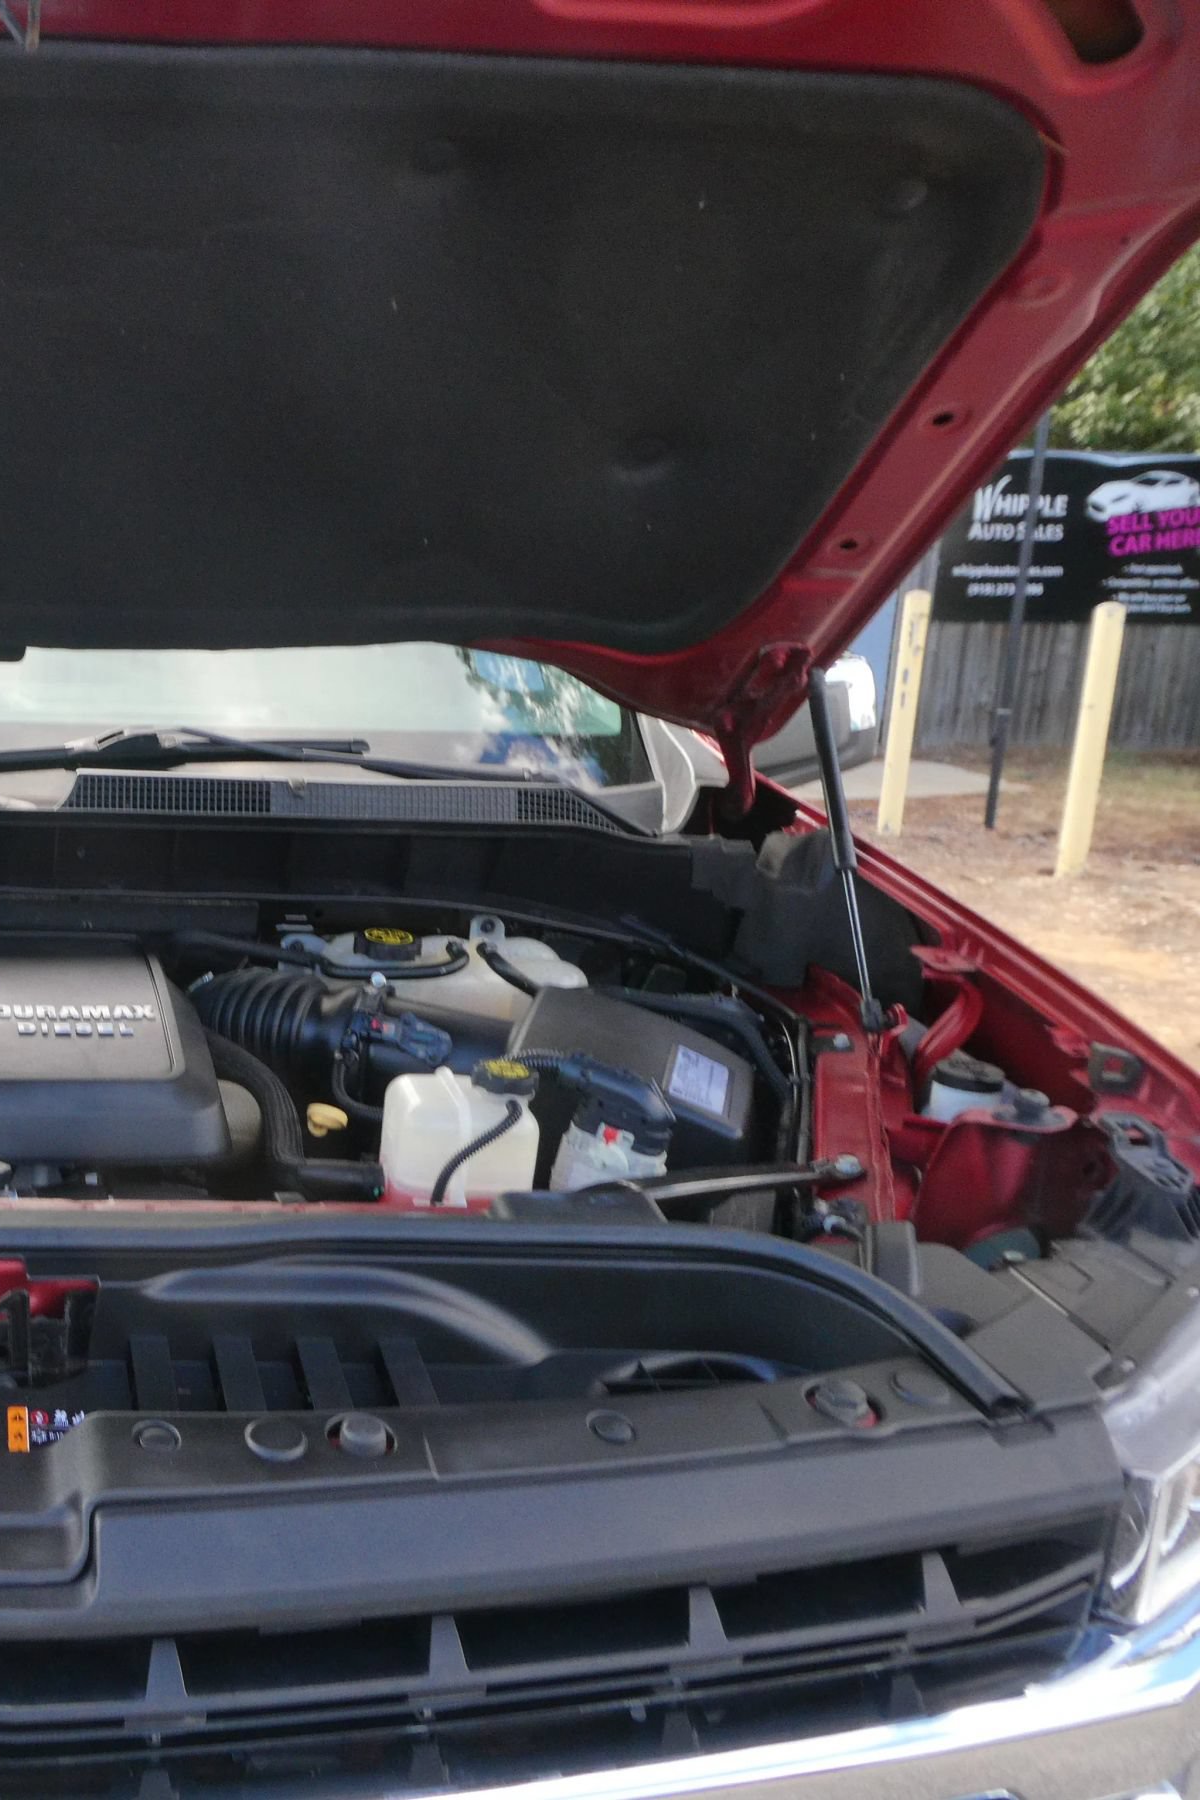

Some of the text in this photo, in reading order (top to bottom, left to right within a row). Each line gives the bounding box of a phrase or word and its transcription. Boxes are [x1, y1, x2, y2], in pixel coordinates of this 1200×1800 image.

[1106, 512, 1153, 536] SELL
[1109, 533, 1152, 557] CAR
[17, 1021, 134, 1037] DIESEL
